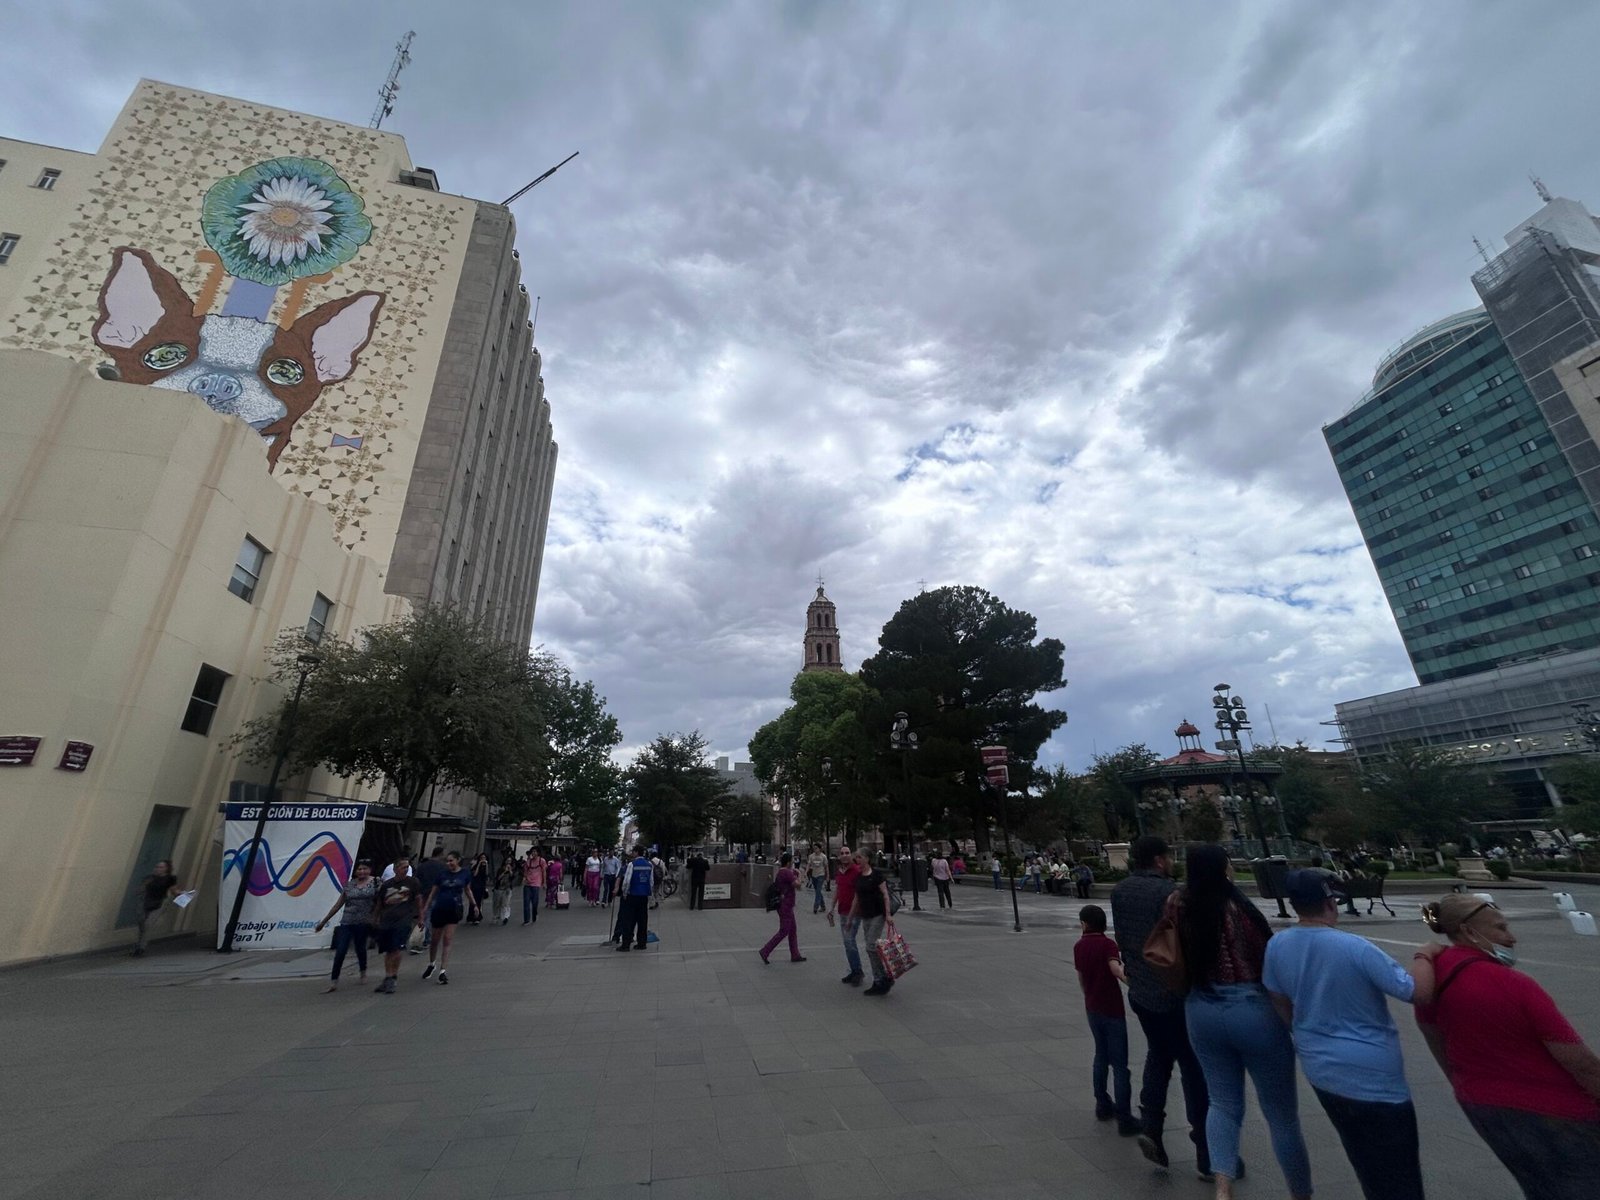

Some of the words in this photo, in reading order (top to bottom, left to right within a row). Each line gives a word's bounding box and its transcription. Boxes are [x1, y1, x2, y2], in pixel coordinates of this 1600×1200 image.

[241, 805, 292, 819] ESTCIÓN
[294, 807, 309, 819] DE
[311, 807, 358, 819] BOLEROS
[268, 921, 276, 932] y
